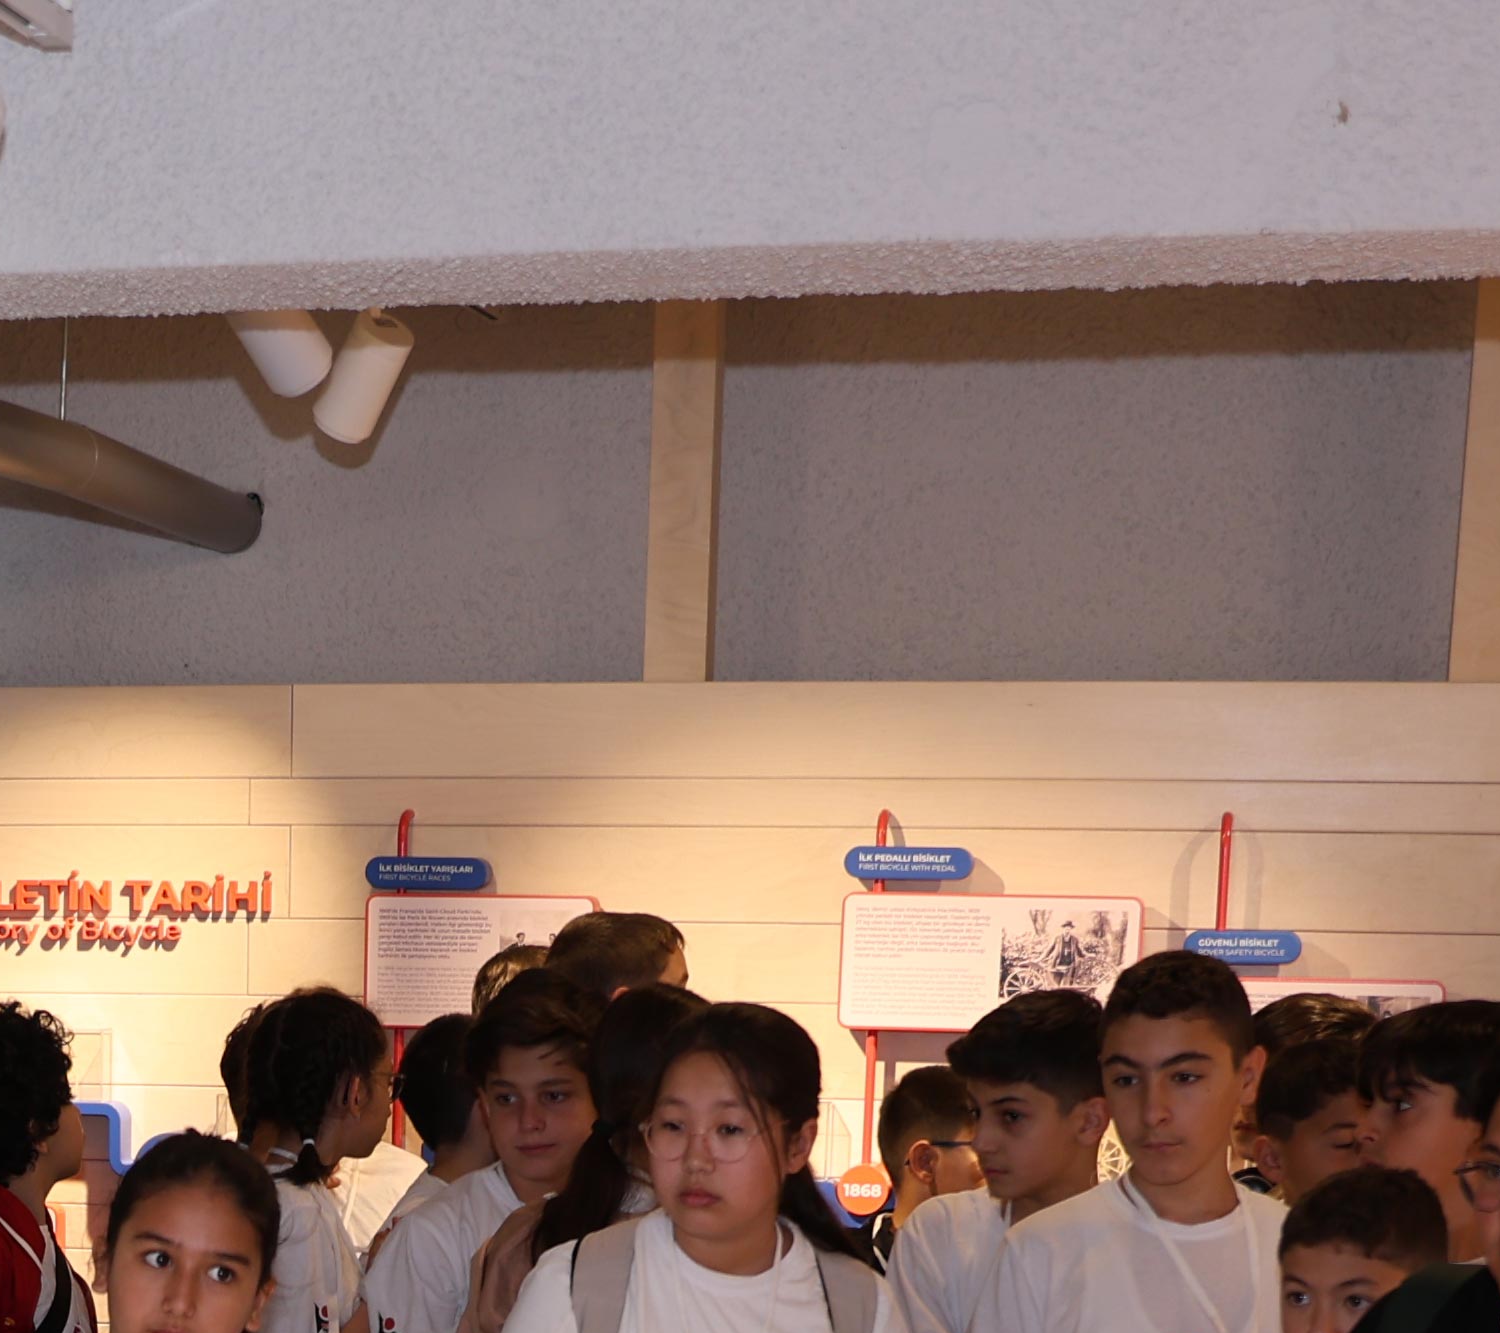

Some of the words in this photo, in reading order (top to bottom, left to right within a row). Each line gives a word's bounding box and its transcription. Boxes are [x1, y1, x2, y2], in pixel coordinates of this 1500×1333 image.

[874, 853, 911, 863] PEDALLI
[912, 853, 952, 864] BİSİKLET
[393, 863, 430, 873] BİSİKLET
[431, 864, 474, 875] YARIŞLARI
[858, 863, 879, 871] FIRST
[879, 863, 910, 871] BICYCLE
[378, 873, 398, 881] FIRST
[428, 874, 452, 882] RACES
[124, 870, 273, 913] TARİHİ
[46, 917, 75, 940] of
[82, 918, 183, 947] Bicycle
[1198, 936, 1238, 948] GÜVENLİ
[1239, 937, 1280, 948] BİSİKLET
[1225, 948, 1253, 957] SAFETY
[1253, 948, 1286, 957] BICYCLE
[843, 1183, 882, 1198] 1868
